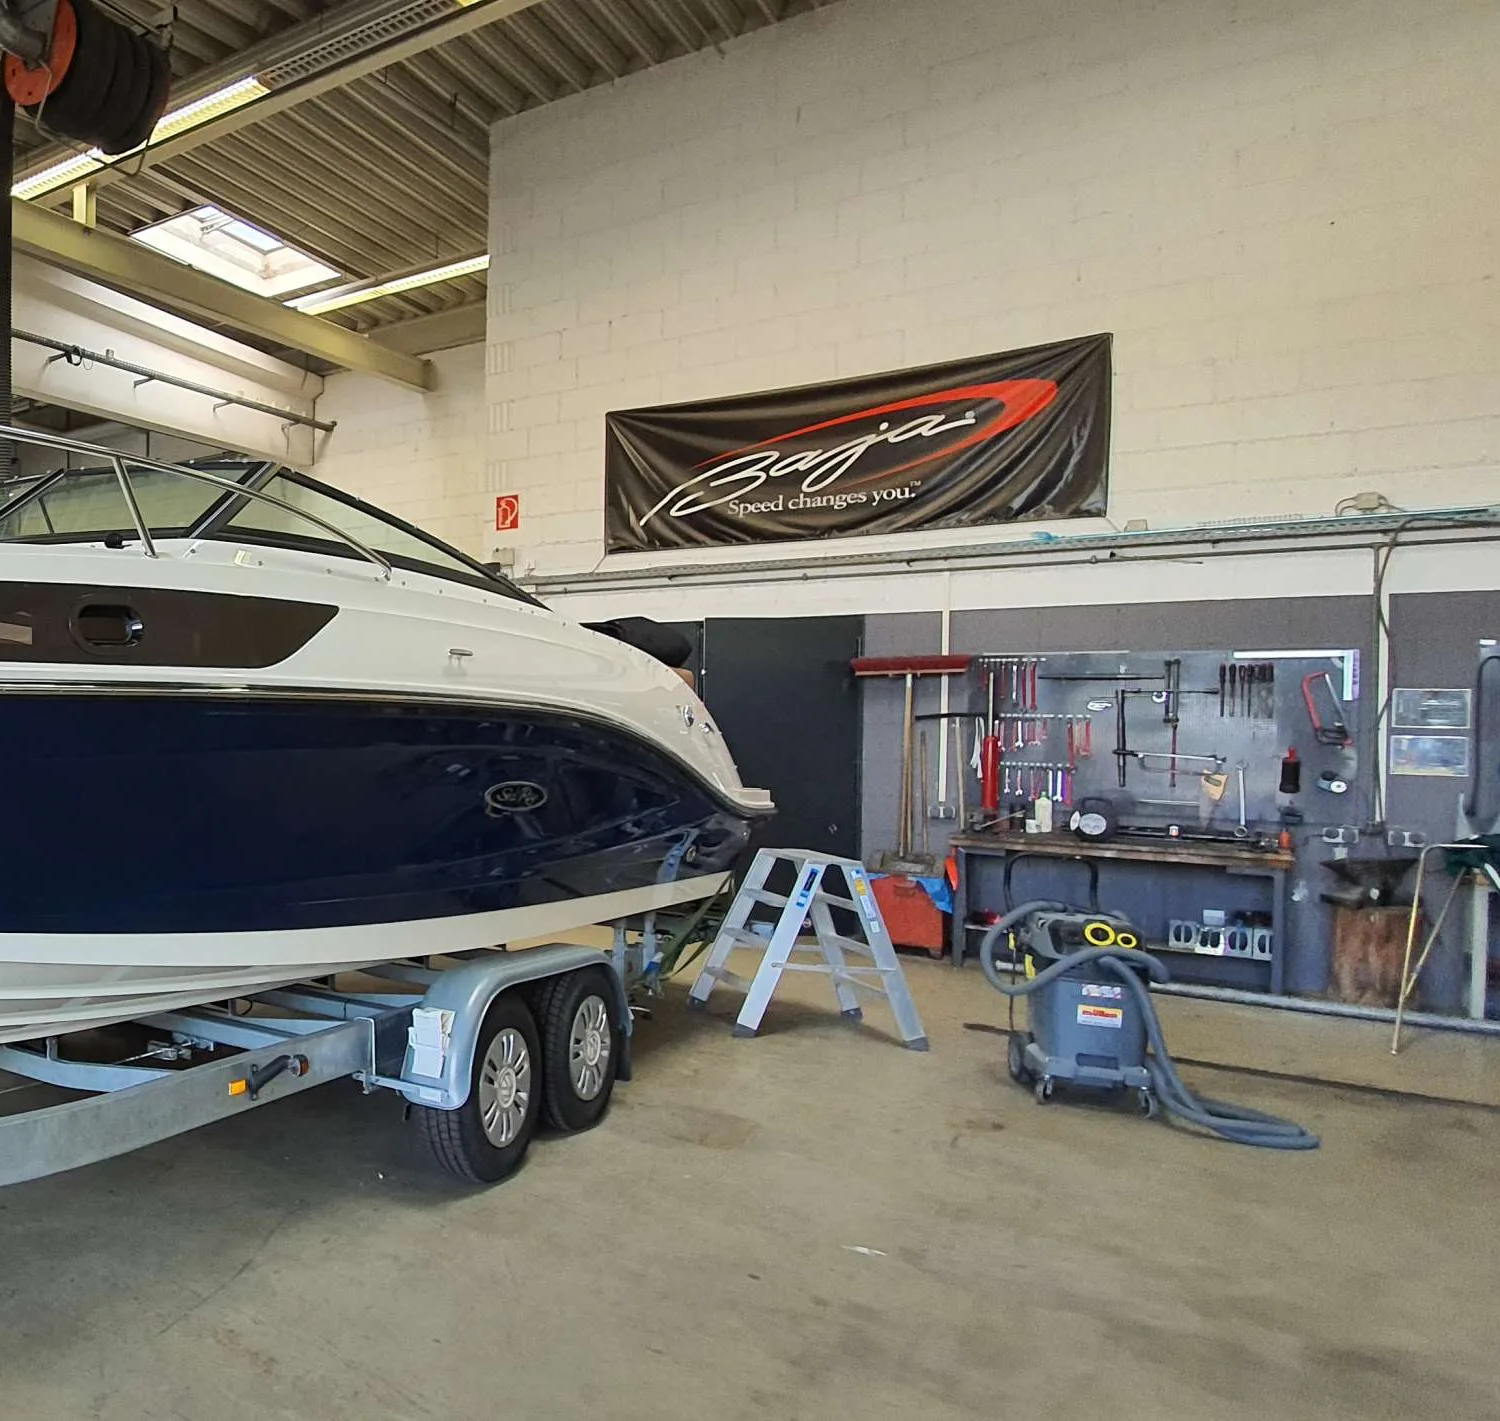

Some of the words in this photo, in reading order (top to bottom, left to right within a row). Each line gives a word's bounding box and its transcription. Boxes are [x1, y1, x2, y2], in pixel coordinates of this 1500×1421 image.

[639, 411, 977, 527] Baja
[728, 494, 784, 518] Speed
[787, 491, 868, 511] changes
